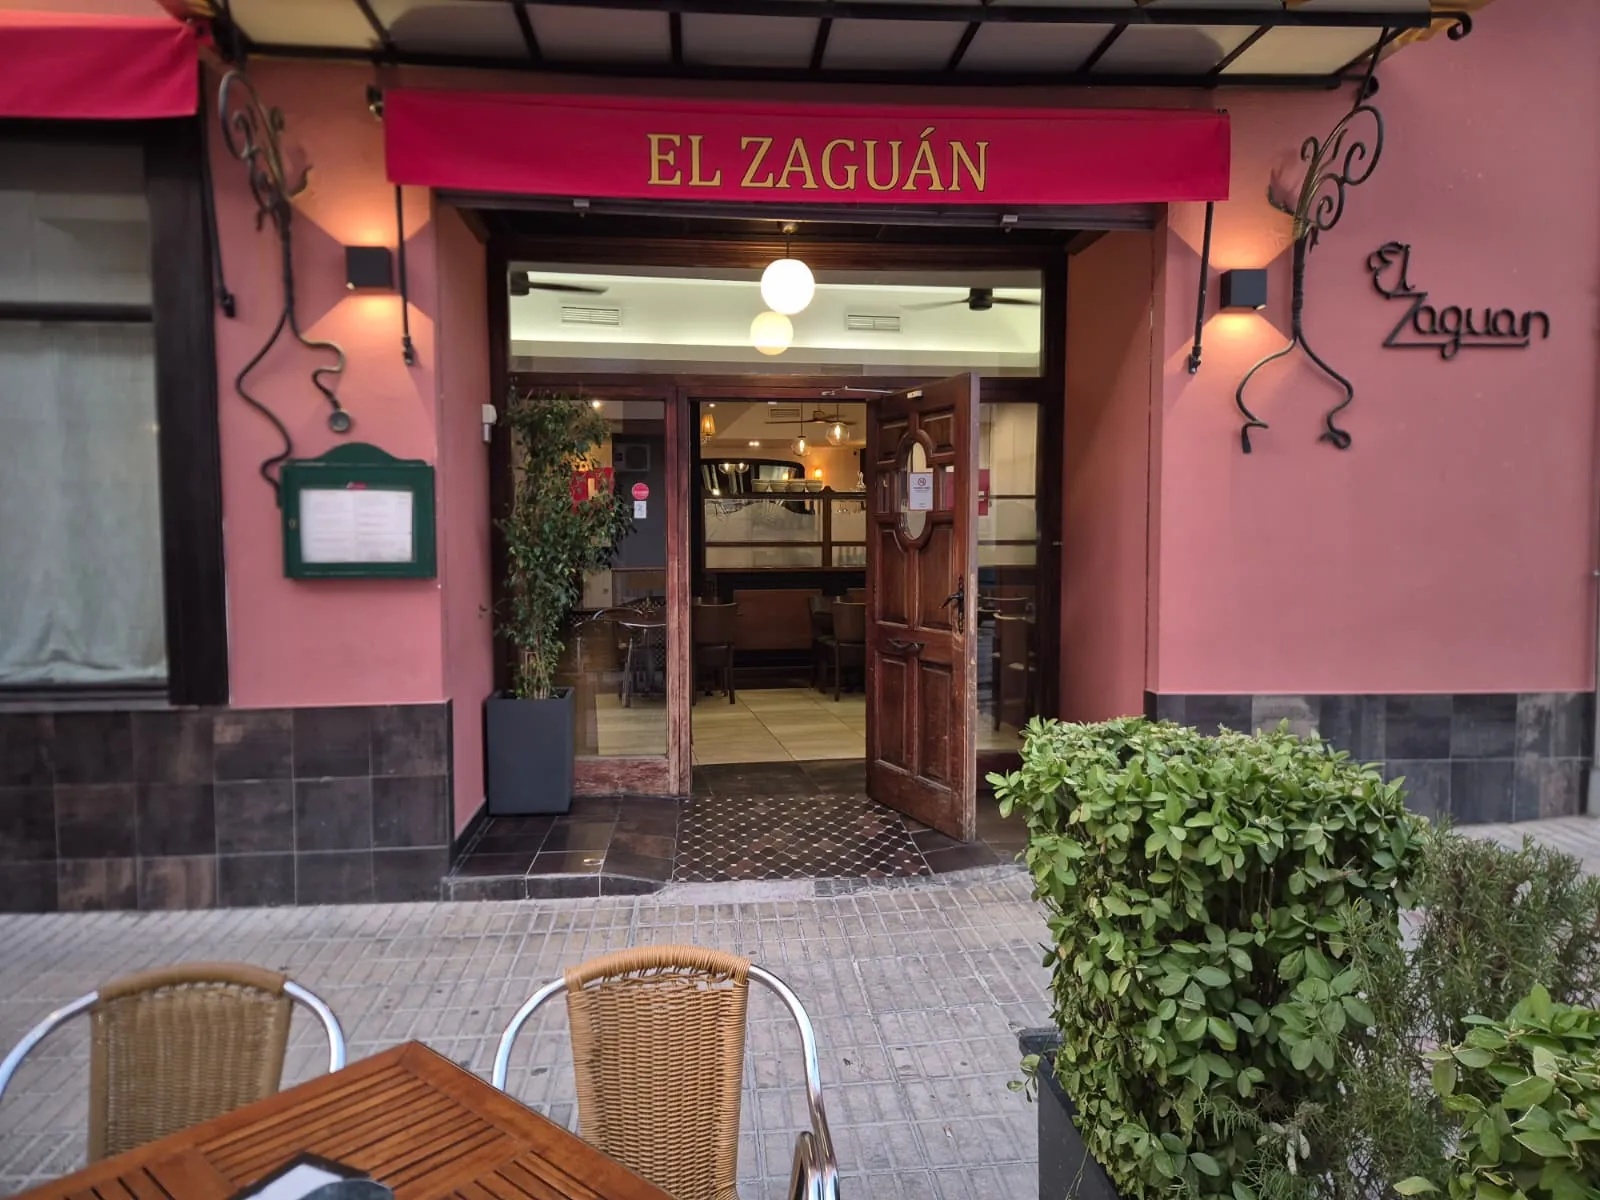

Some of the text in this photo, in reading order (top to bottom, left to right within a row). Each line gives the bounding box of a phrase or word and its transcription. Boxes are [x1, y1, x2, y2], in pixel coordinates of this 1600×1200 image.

[647, 127, 989, 192] EL ZAGUÁN
[1366, 241, 1416, 299] El
[1381, 291, 1550, 361] Zaguan
